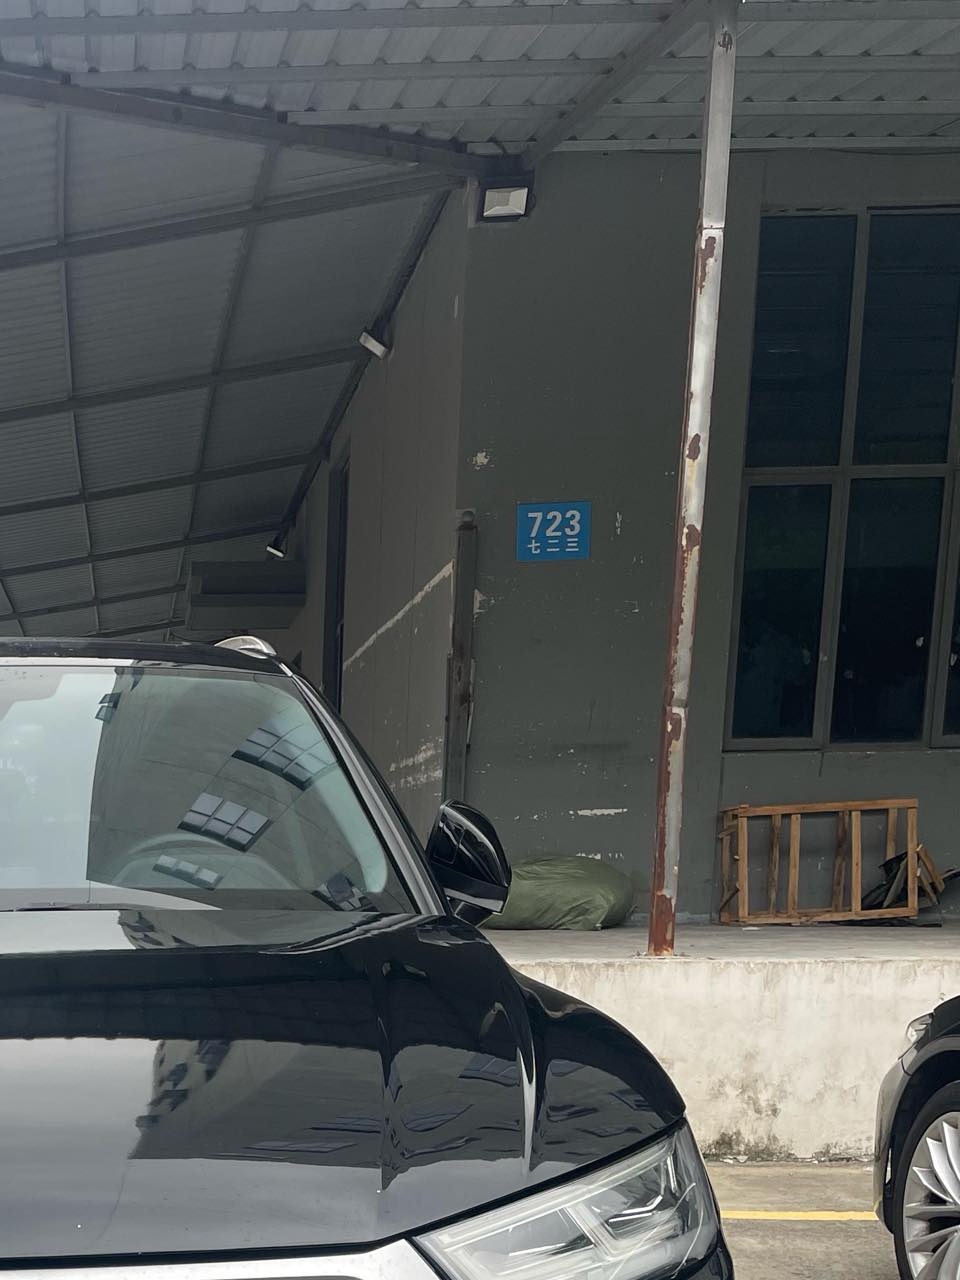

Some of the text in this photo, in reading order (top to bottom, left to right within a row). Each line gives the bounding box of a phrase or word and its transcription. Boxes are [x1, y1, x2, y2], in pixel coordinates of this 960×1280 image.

[527, 510, 581, 538] 723
[527, 538, 580, 554] 七二三
